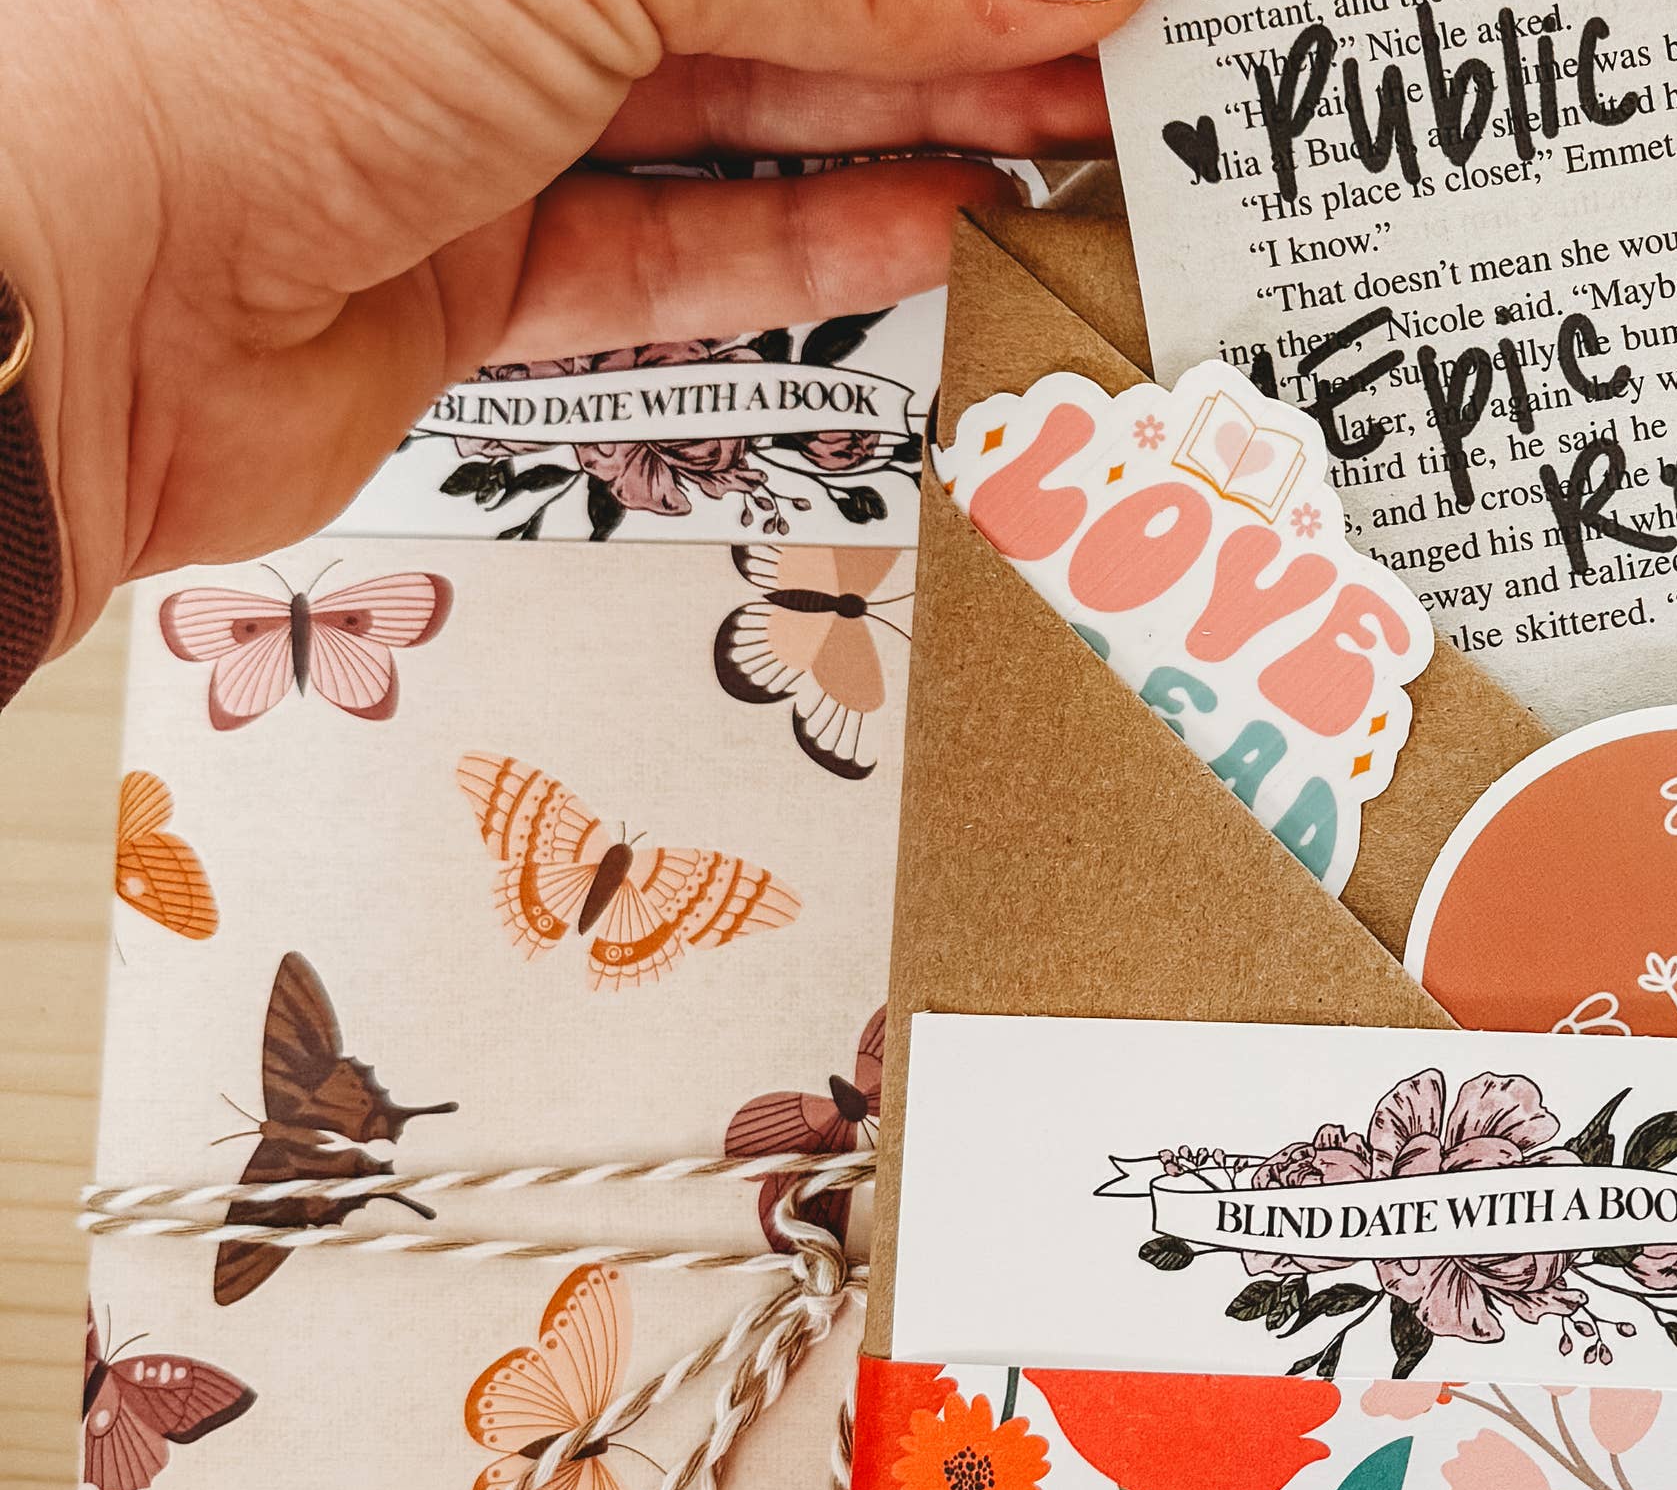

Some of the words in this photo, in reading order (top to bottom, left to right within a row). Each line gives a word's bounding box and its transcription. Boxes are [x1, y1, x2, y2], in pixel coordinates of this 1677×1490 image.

[1320, 179, 1402, 218] place
[1562, 131, 1676, 173] Emmet
[1248, 239, 1282, 267] “I
[1286, 221, 1392, 264] know.”
[1350, 258, 1461, 300] doesn’t
[1468, 250, 1552, 281] mean
[1558, 235, 1611, 267] she
[1382, 302, 1486, 341] Nicole
[1493, 288, 1563, 324] said.
[433, 394, 536, 426] BLIND
[544, 392, 643, 426] DATE
[641, 382, 738, 416] WITH
[746, 382, 773, 411] A
[778, 380, 880, 417] BOOK
[1299, 304, 1637, 507] Epic
[1329, 450, 1406, 487] third
[1506, 431, 1547, 460] he
[1370, 493, 1427, 527] and
[1486, 523, 1534, 554] his
[970, 402, 1411, 738] LOVE
[1502, 563, 1560, 597] and
[1514, 598, 1656, 643] skittered.
[1216, 1200, 1332, 1239] BLIND
[1339, 1199, 1438, 1238] DATE
[1446, 1188, 1555, 1230] WITH
[1562, 1187, 1589, 1222] A
